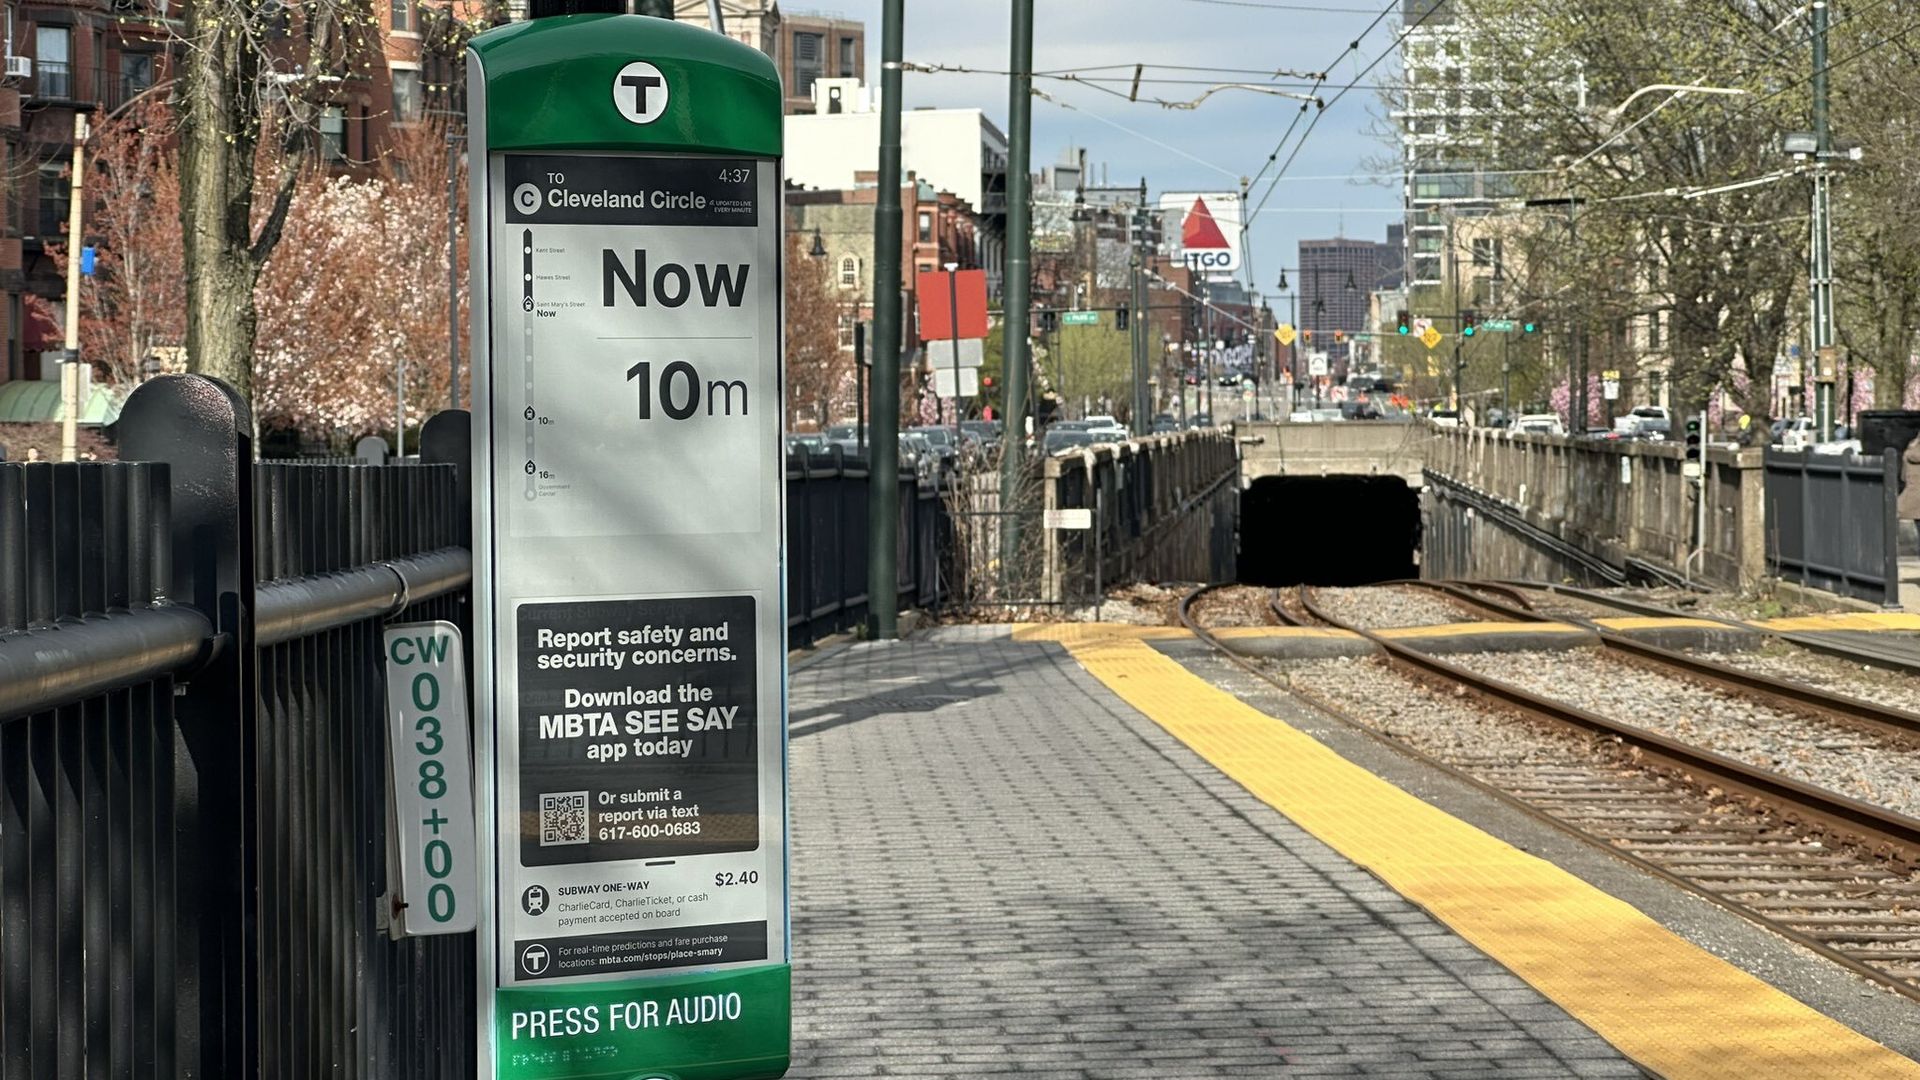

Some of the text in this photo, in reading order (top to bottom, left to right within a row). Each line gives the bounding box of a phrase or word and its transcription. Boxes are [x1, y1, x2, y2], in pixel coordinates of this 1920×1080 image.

[621, 75, 661, 114] T
[547, 172, 565, 185] TO
[718, 168, 750, 184] 4:37
[521, 191, 534, 207] C
[547, 188, 706, 210] Cleveland Circle
[1184, 252, 1231, 267] ITGO
[603, 248, 750, 308] Now
[536, 309, 557, 318] Now
[626, 360, 748, 421] 10m
[537, 416, 555, 425] 10m
[538, 470, 556, 479] 16m
[537, 626, 612, 651] Report
[617, 625, 683, 647] safety
[689, 622, 728, 642] and
[390, 635, 450, 666] CW
[537, 645, 737, 670] security concerns.
[564, 684, 671, 709] Download
[678, 684, 713, 703] the
[539, 705, 739, 740] MBTA SEE SAY
[586, 736, 693, 763] app today
[598, 788, 682, 806] Or submit a
[598, 804, 699, 825] report via text
[599, 821, 701, 841] 617-600-0683
[558, 880, 650, 897] SUBWAY ONE-WAY
[715, 870, 759, 888] $2.40
[558, 892, 709, 914] CharlieCard, CharlieTicket, or cash
[558, 908, 681, 928] payment accepted on board
[558, 933, 728, 957] For real-time predictions and fare purchase
[526, 951, 545, 970] T
[558, 947, 723, 969] locations: mbta.com/stops/place-smary
[511, 992, 741, 1040] PRESS FOR AUDIO
